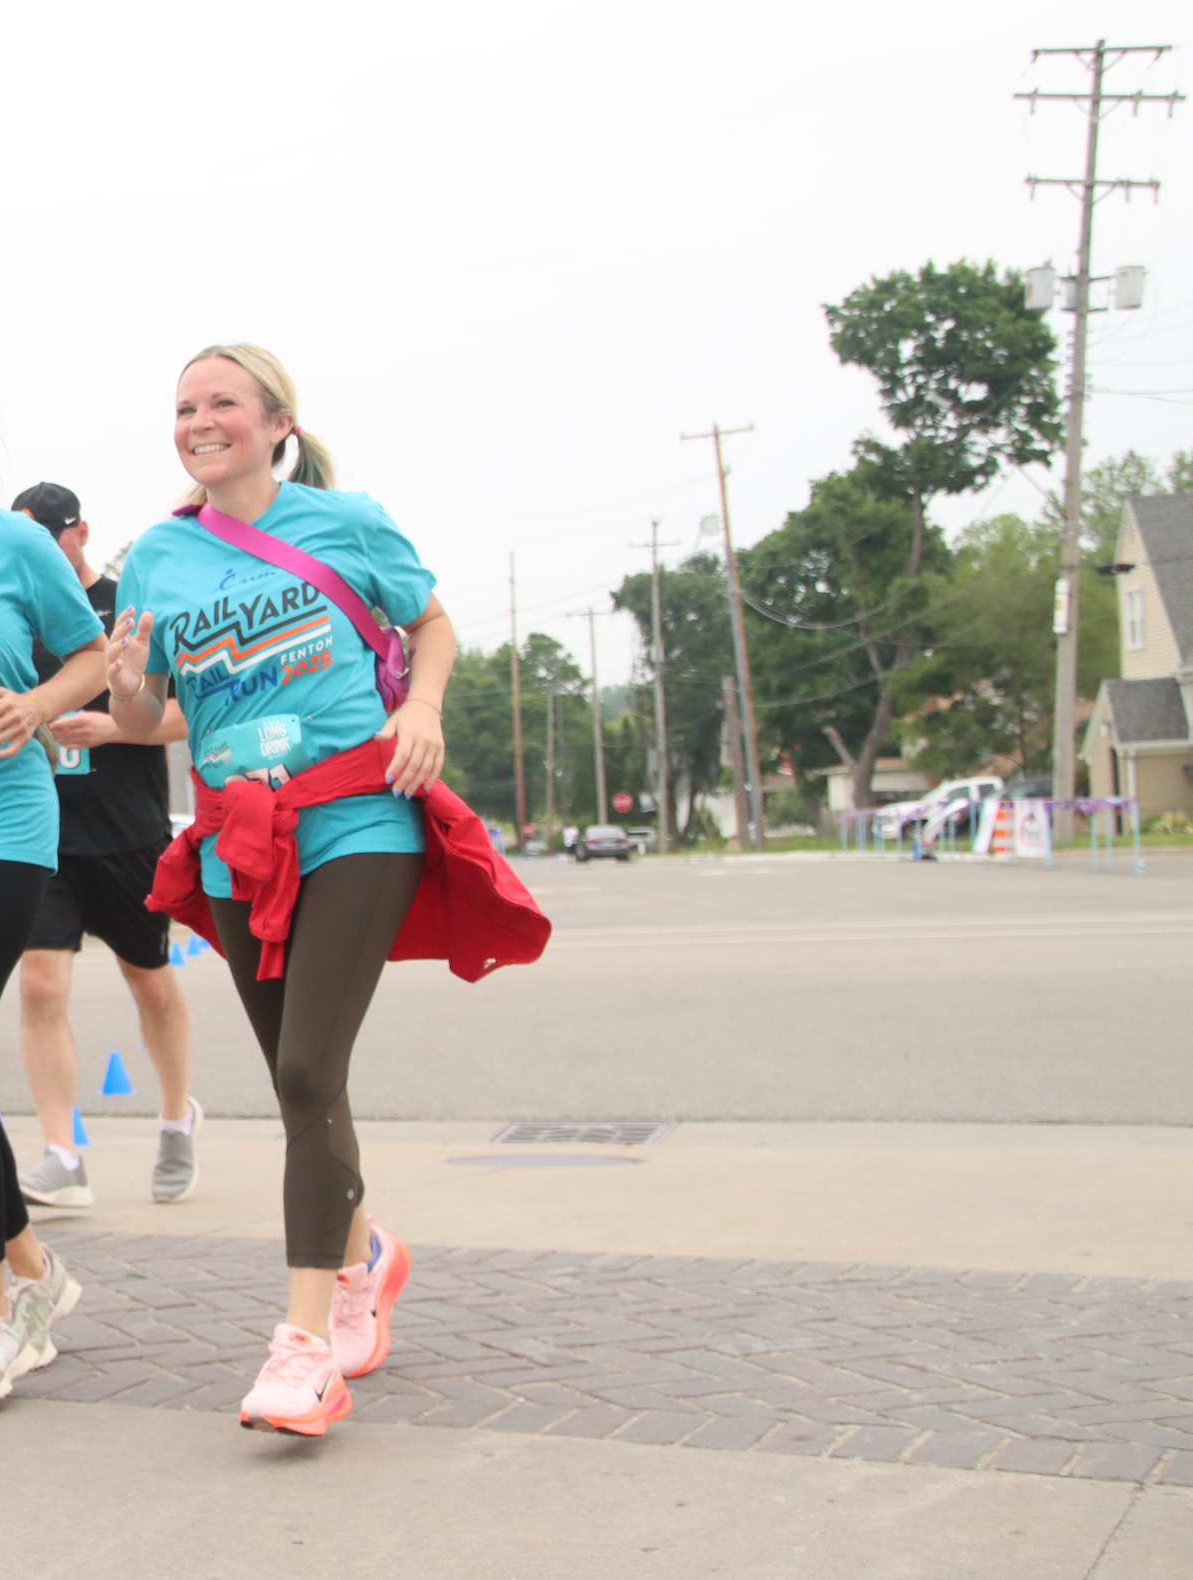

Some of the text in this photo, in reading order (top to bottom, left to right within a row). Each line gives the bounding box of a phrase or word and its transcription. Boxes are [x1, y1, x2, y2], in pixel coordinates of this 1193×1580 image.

[170, 581, 320, 657] RAILYARD
[280, 635, 333, 665] FENTON
[186, 667, 230, 700] RAIL
[280, 649, 333, 685] 2025
[224, 667, 278, 706] RUN
[258, 723, 287, 742] LONG
[260, 736, 292, 757] DRINK
